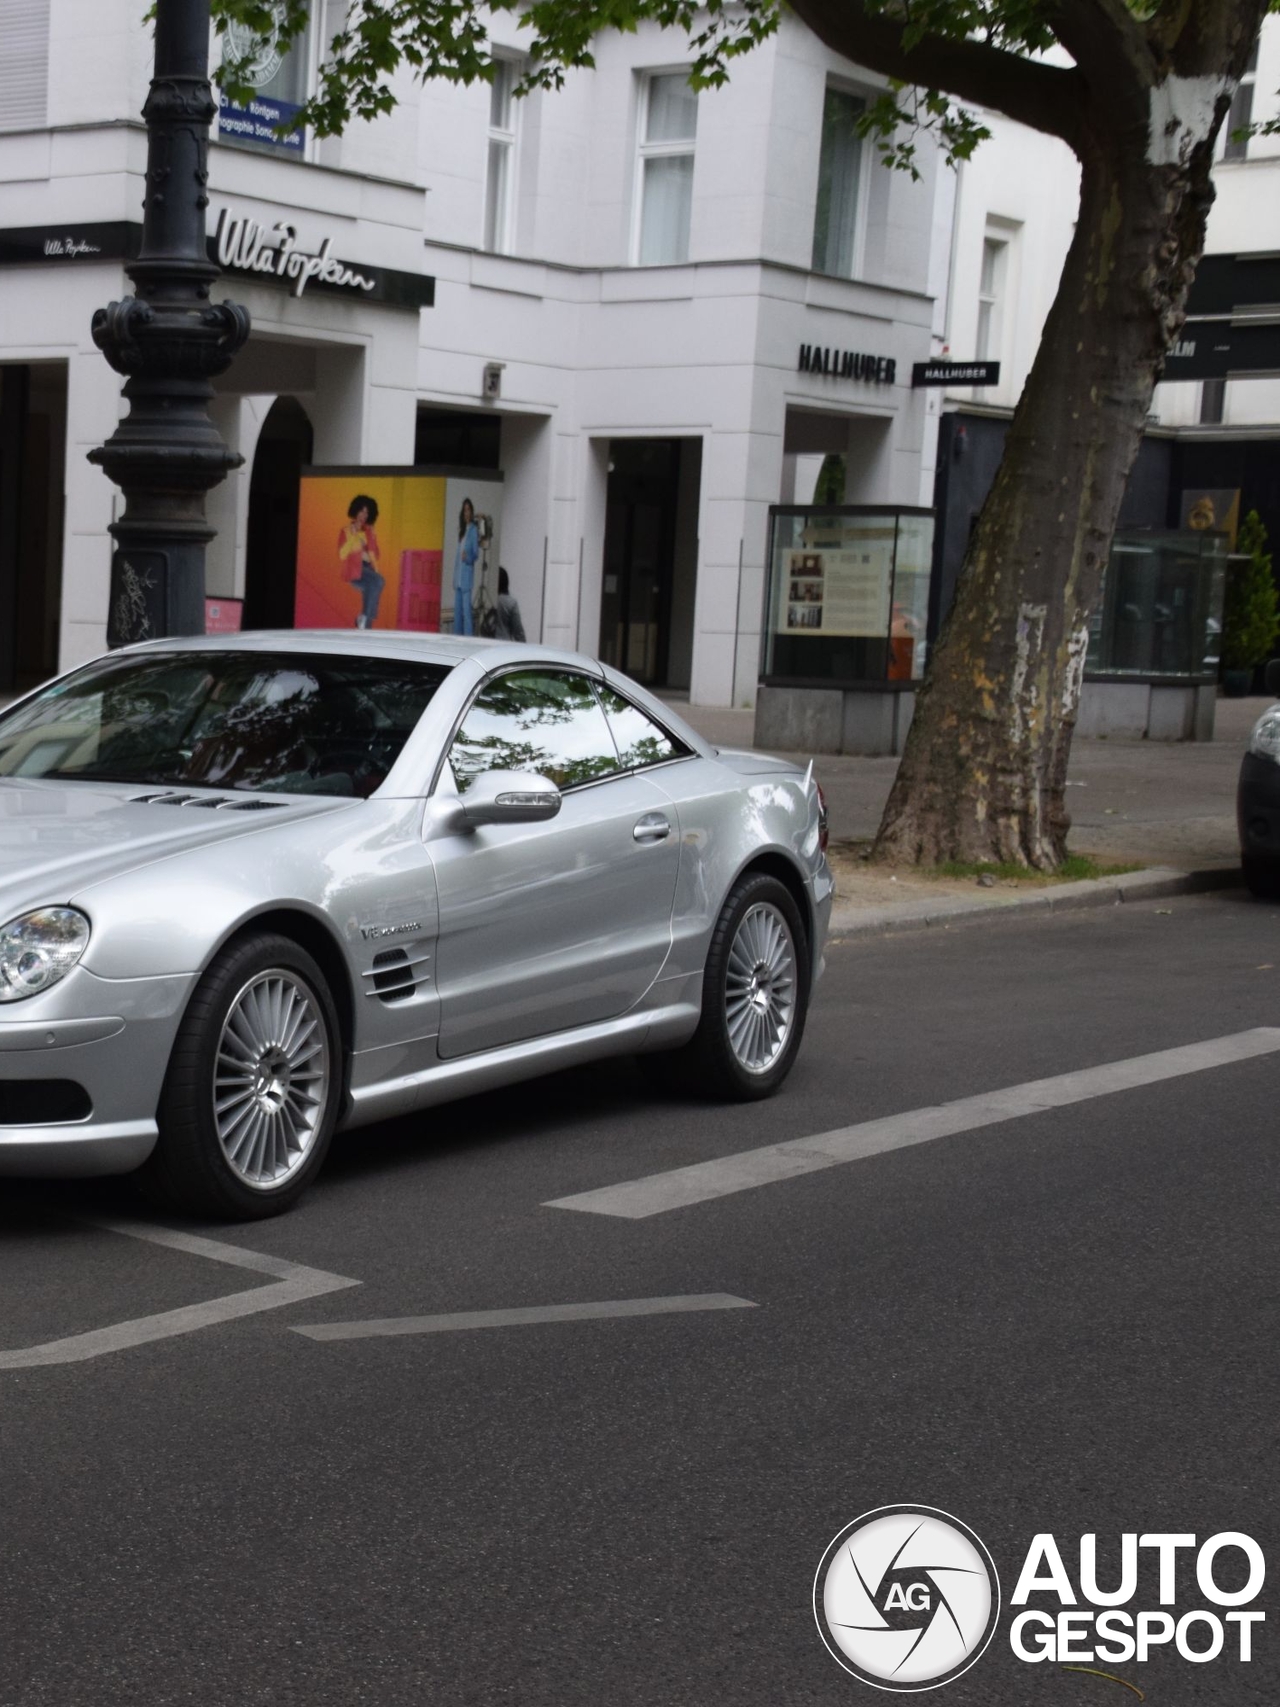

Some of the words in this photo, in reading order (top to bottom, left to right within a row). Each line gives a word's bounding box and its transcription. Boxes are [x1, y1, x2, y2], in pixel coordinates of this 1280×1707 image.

[249, 102, 280, 120] Röntgen
[44, 239, 64, 256] Ulla
[64, 238, 101, 258] Popken
[218, 208, 275, 273] Ulla
[273, 222, 375, 297] Popken
[799, 344, 896, 384] HALLHUBER
[924, 367, 987, 380] HALLHUBER
